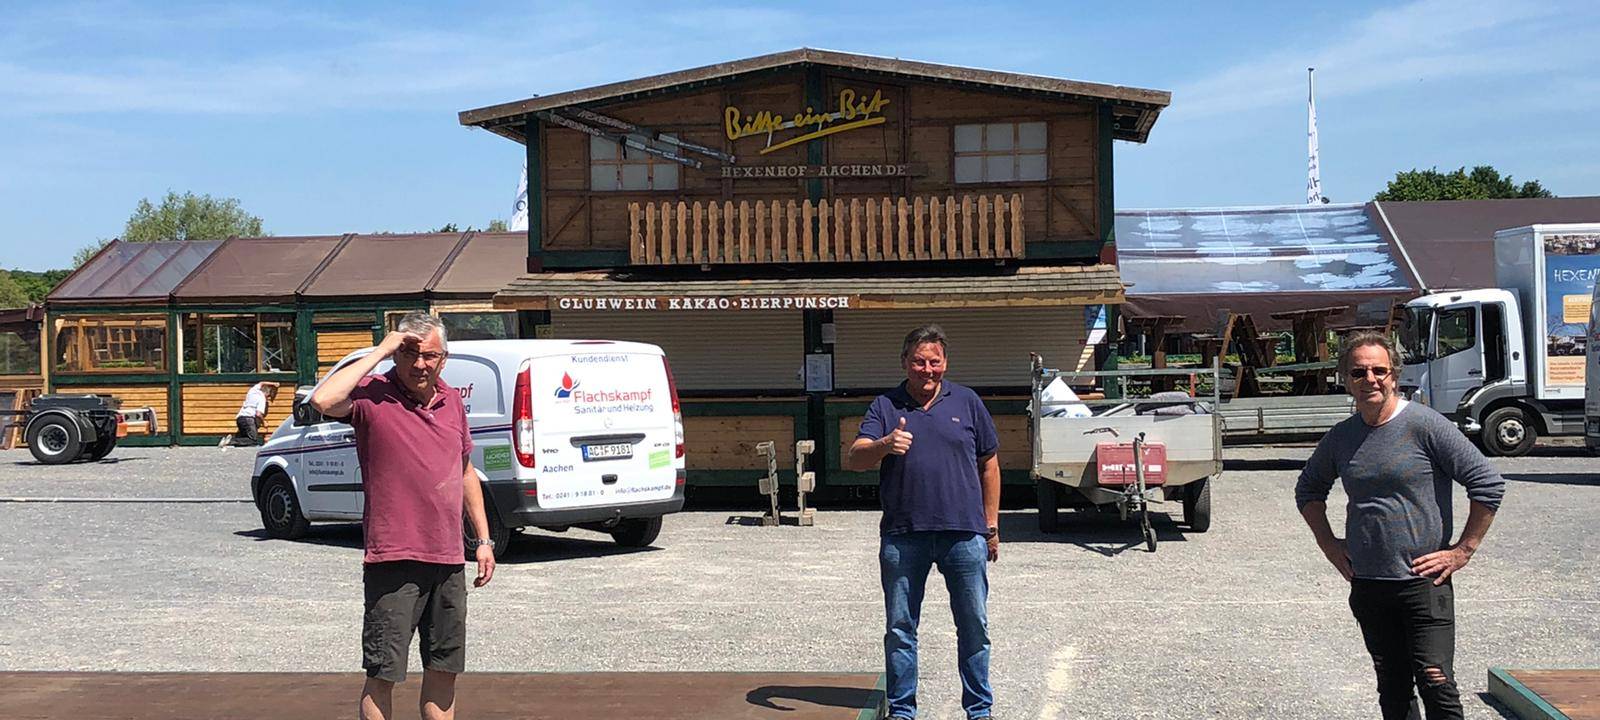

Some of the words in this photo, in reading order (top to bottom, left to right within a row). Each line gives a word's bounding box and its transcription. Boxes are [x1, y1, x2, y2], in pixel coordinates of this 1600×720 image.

[725, 106, 784, 140] Bitte
[794, 107, 833, 127] ein
[840, 89, 890, 119] Bit
[721, 166, 807, 177] HEXENHOF
[668, 298, 730, 309] KAKAO
[741, 296, 849, 309] EIERPUNSCH
[571, 355, 629, 363] Kundendienst
[574, 388, 652, 403] Flachskampf
[607, 404, 622, 413] und
[624, 402, 654, 413] Heizung
[589, 447, 599, 457] AC
[611, 445, 631, 455] 9181
[543, 464, 574, 473] Aachen
